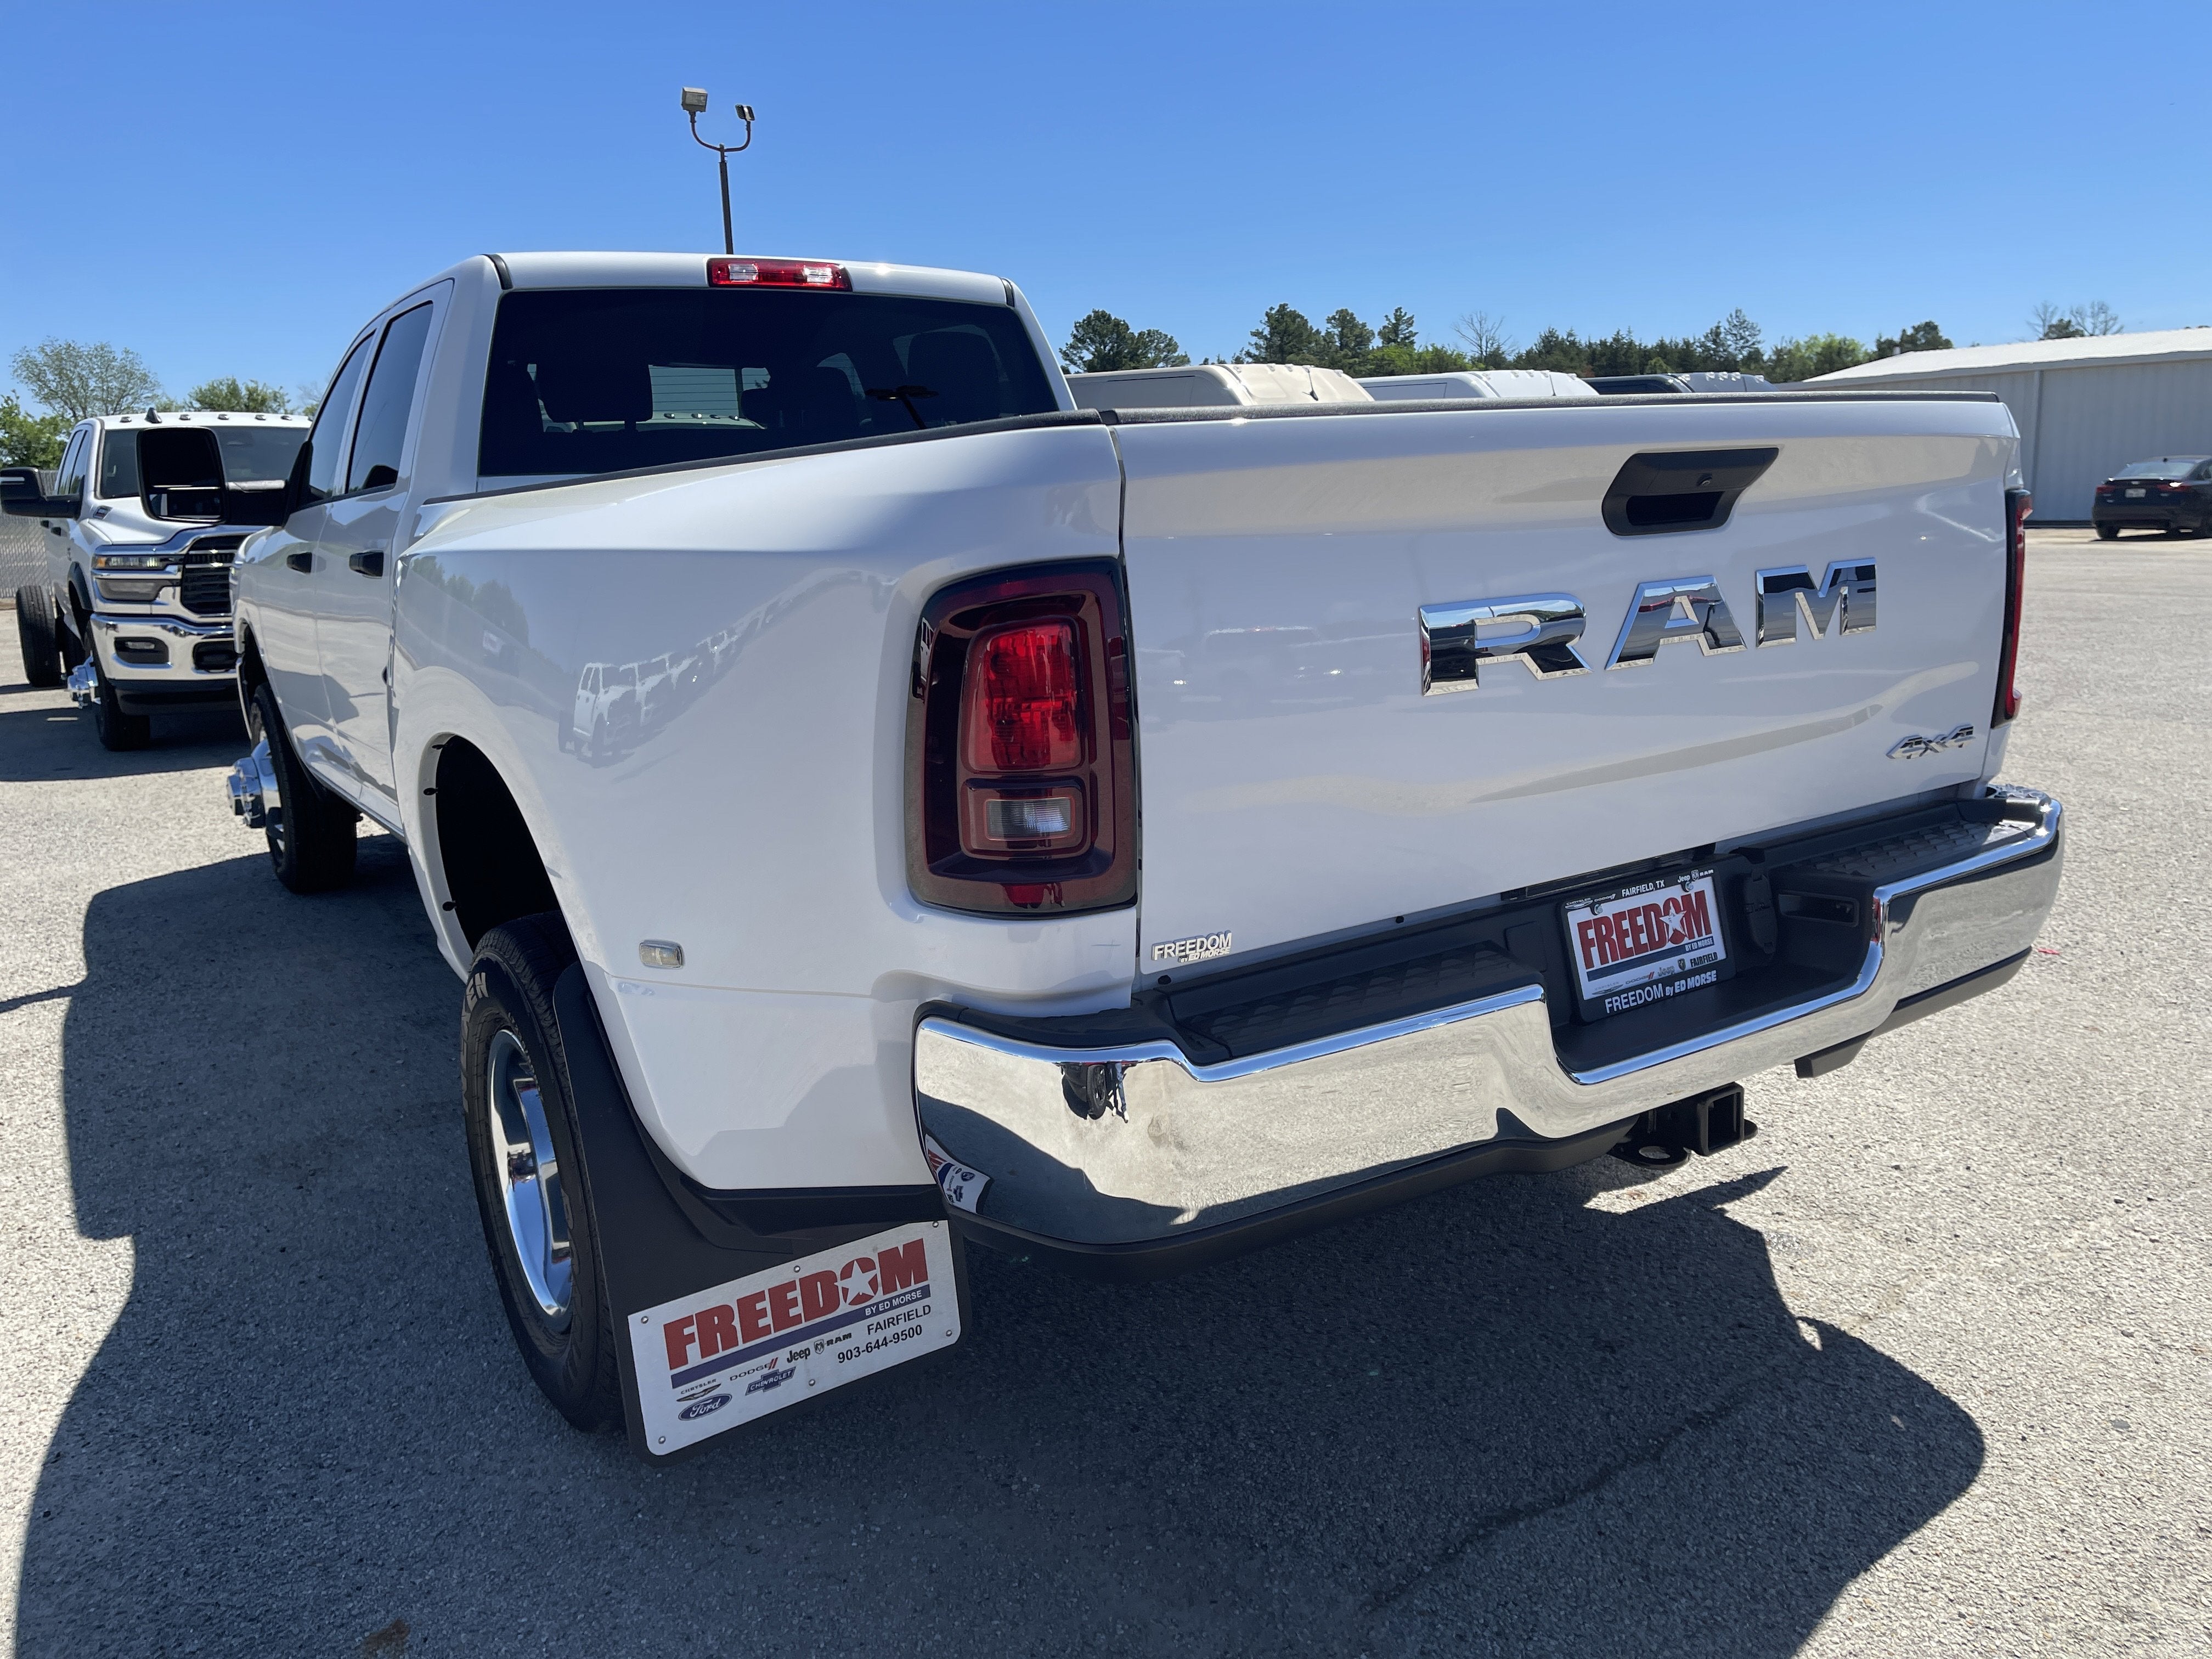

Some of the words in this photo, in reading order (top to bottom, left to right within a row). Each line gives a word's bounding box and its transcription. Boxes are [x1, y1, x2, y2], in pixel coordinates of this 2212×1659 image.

[1420, 557, 1877, 697] RAM
[1622, 882, 1655, 898] FAIRFIELD,
[1656, 879, 1665, 889] TX
[1678, 875, 1690, 883] Jeep
[1577, 890, 1713, 970] FREEDOM
[1153, 932, 1232, 960] FREEDOM
[1188, 952, 1200, 961] ED
[1200, 947, 1231, 959] MORSE
[1685, 944, 1692, 952] BY
[1698, 938, 1713, 948] MORSE
[1690, 952, 1718, 968] FAIRFIELD
[1657, 966, 1675, 977] Jeep
[1605, 983, 1664, 1014] FREEDOM
[1674, 980, 1686, 994] ED
[1687, 969, 1717, 990] MORSE
[663, 1238, 929, 1370] FREEDOM
[865, 1305, 877, 1316] BY
[879, 1301, 890, 1311] ED
[892, 1290, 922, 1307] MORSE
[867, 1305, 931, 1335] FAIRFIELD
[826, 1333, 852, 1347] RAM
[837, 1324, 923, 1364] 903-644-9500
[786, 1347, 811, 1363] Jeep
[730, 1364, 771, 1381] DODGE
[749, 1372, 792, 1391] CHEVROLET
[681, 1379, 716, 1395] CHRYSLER
[689, 1398, 721, 1418] Ford
